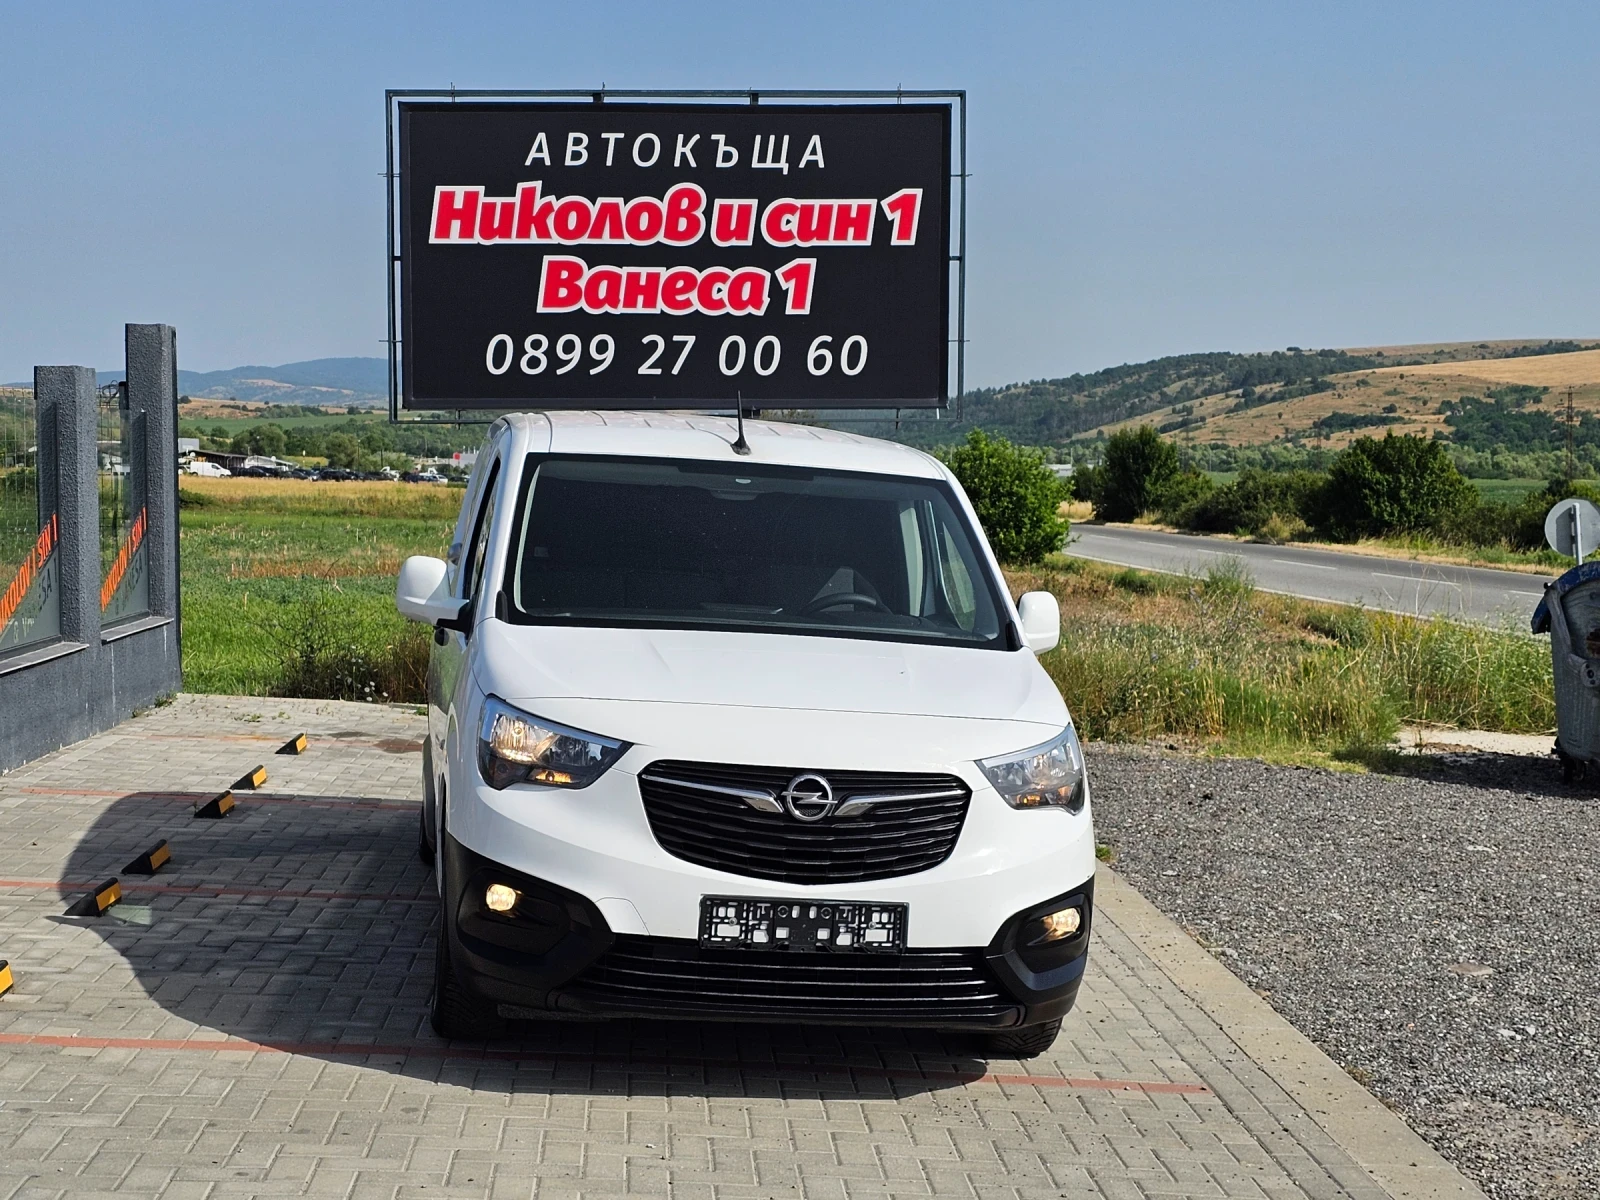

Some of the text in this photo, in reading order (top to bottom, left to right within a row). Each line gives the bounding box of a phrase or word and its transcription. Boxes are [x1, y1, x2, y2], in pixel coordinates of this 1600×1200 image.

[524, 132, 826, 176] АВТОКЪЩА
[429, 180, 924, 248] Николов и син 1
[536, 255, 818, 316] Ванеса 1
[485, 333, 869, 377] 0899 27 00 60
[0, 555, 31, 634] IKOLOV
[37, 523, 51, 569] SIN
